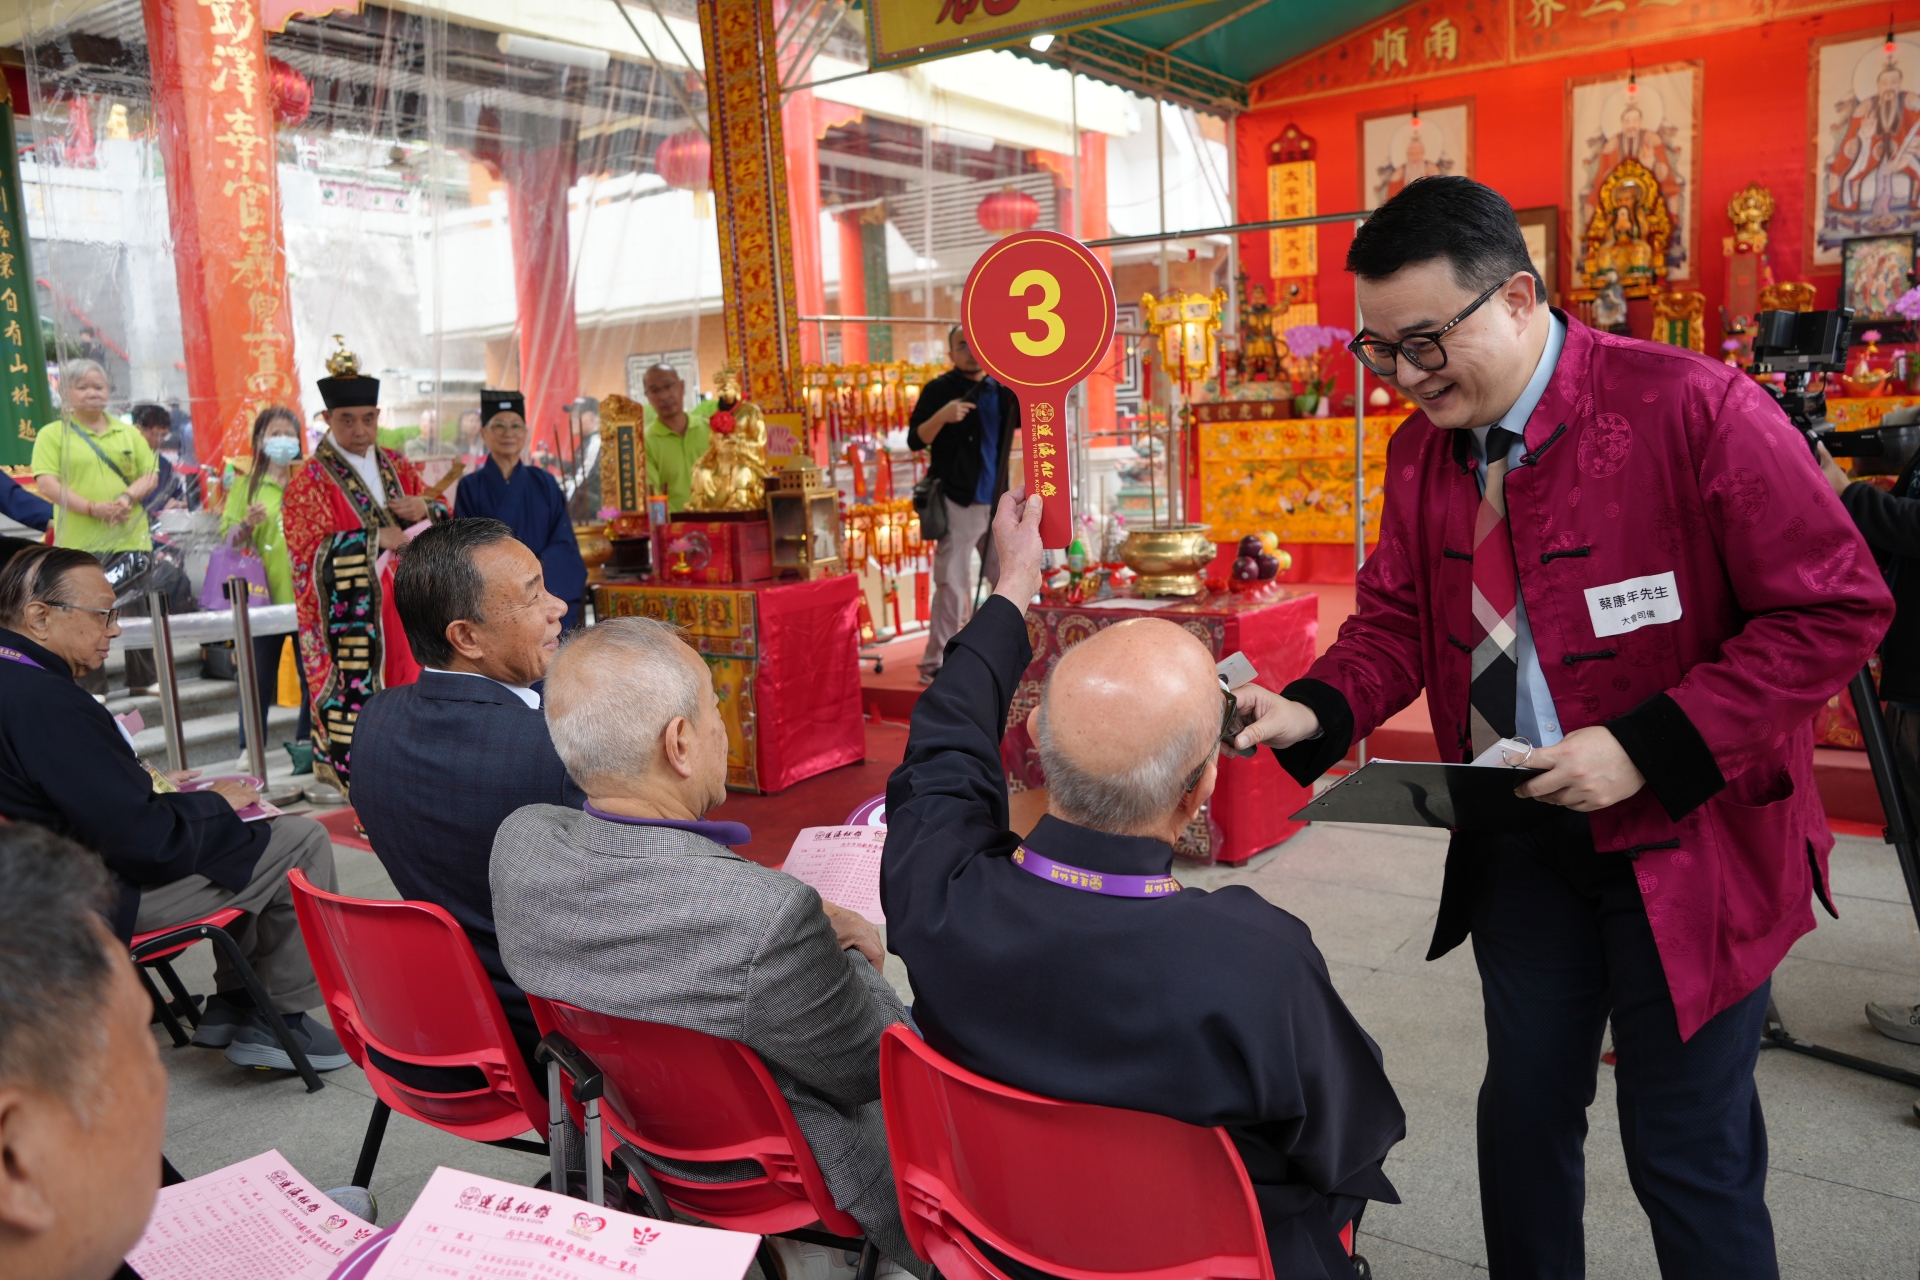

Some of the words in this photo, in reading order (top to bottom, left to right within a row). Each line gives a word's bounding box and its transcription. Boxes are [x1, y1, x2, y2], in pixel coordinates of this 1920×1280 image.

[1008, 269, 1066, 358] 3
[1598, 585, 1669, 610] 蔡康年先生
[1621, 609, 1656, 626] 大會司儀
[473, 1206, 491, 1216] FUNG
[493, 1210, 508, 1219] YING
[508, 1214, 525, 1222] SEEN
[526, 1217, 544, 1225] KOON
